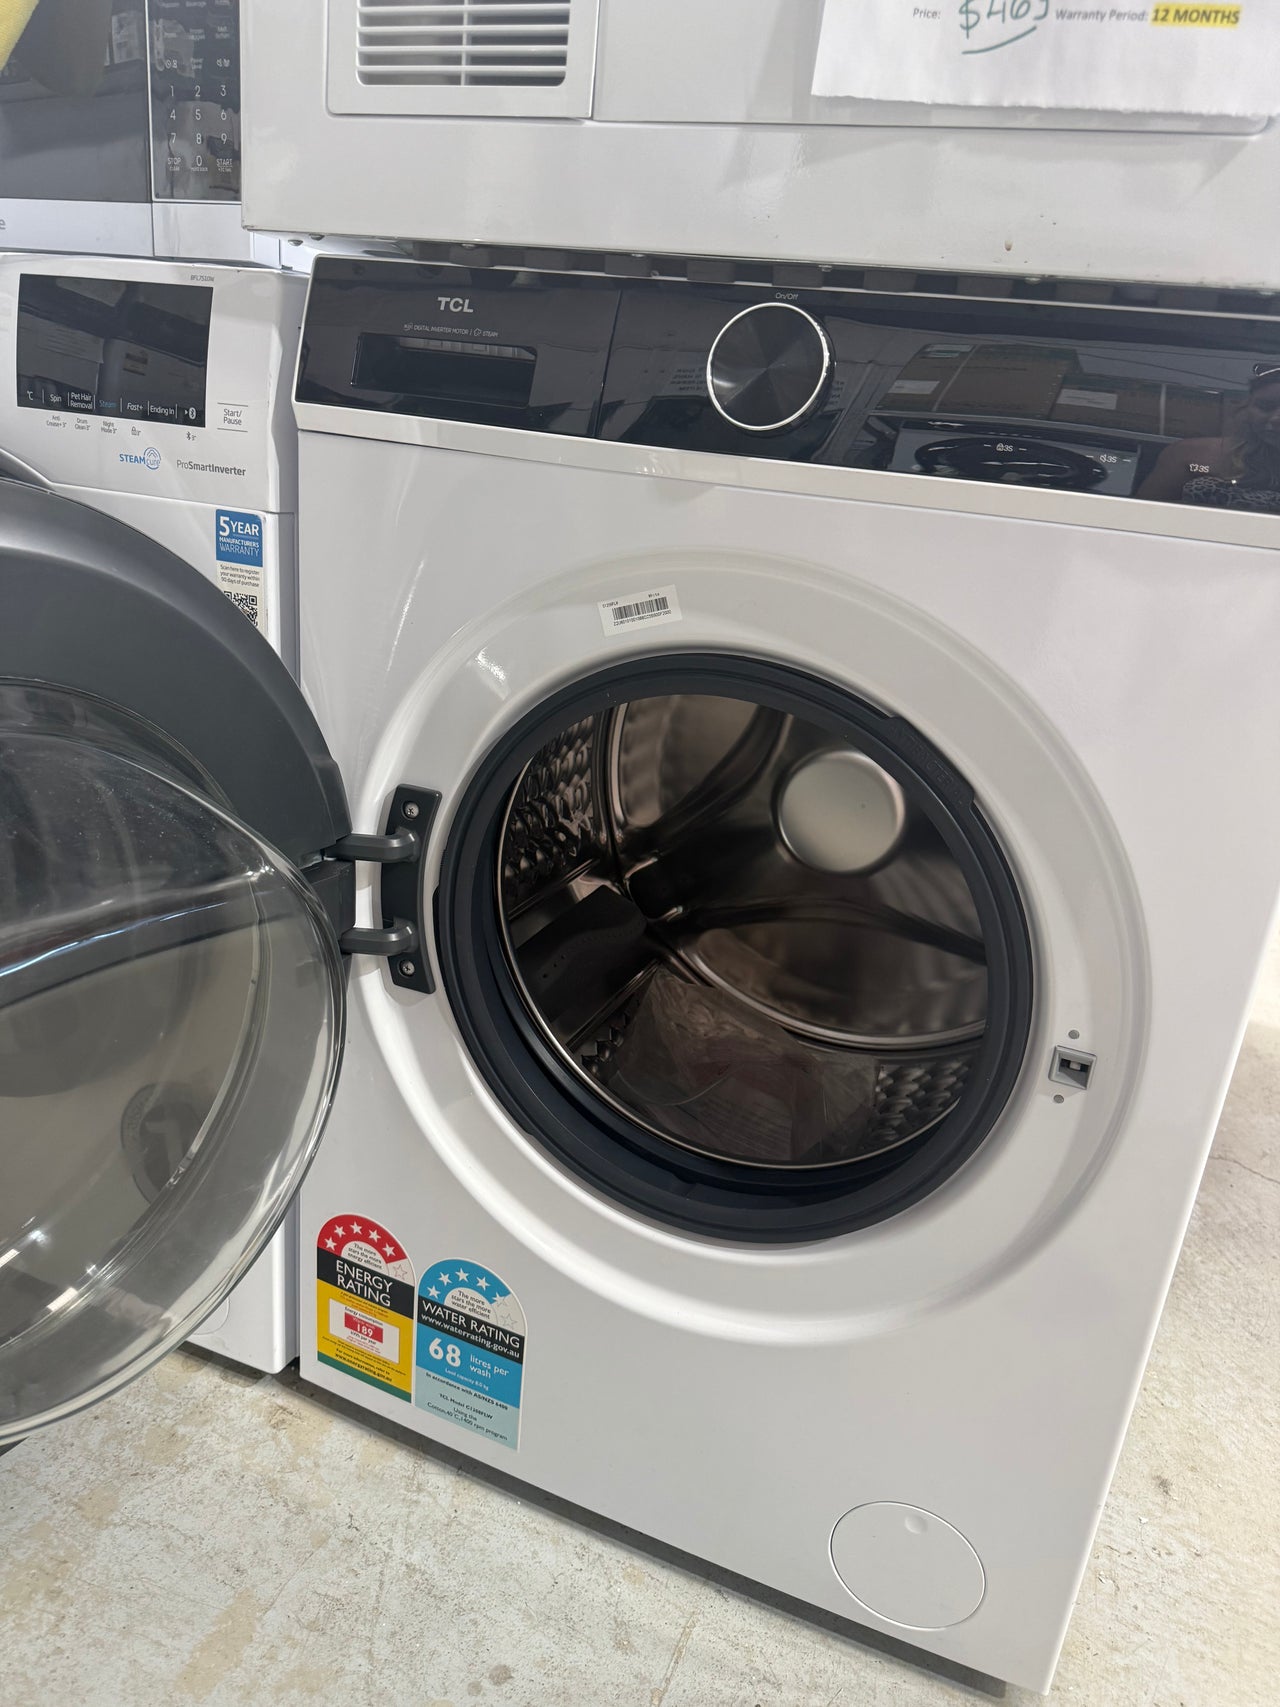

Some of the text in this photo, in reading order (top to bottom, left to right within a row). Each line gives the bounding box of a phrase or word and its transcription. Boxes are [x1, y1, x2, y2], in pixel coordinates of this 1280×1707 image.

[913, 8, 941, 19] Price:
[1055, 9, 1240, 24] Warranty Period: 12 MONTHS
[170, 85, 174, 96] 1
[194, 85, 201, 97] 2
[220, 85, 227, 97] 3
[170, 109, 176, 121] 4
[195, 109, 202, 120] 5
[220, 109, 227, 120] 6
[171, 133, 177, 144] 7
[196, 133, 202, 144] 8
[220, 133, 227, 144] 9
[167, 157, 182, 165] STOP
[196, 155, 203, 167] 0
[216, 158, 233, 166] START
[775, 292, 799, 300] On/Off
[438, 296, 474, 313] TCL
[452, 328, 469, 336] MOTOR
[50, 393, 62, 403] Spin
[70, 392, 92, 402] Pet Hair
[70, 400, 93, 410] Removal
[99, 399, 117, 408] Steam
[126, 402, 144, 412] Fast+
[150, 404, 175, 416] Ending In
[223, 408, 242, 418] Start/
[223, 416, 242, 426] Pause
[176, 460, 246, 476] ProSmartInverter
[219, 515, 259, 537] 5 YEAR
[219, 536, 260, 548] MANUFACTURERS
[219, 543, 260, 557] WARRANTY
[348, 1247, 382, 1264] stars the more
[354, 1242, 377, 1257] The more
[347, 1252, 382, 1269] energy efficient
[336, 1259, 393, 1293] ENERGY
[337, 1274, 391, 1307] RATING
[451, 1294, 492, 1314] stars the more
[458, 1290, 485, 1306] The more
[344, 1306, 358, 1316] Energy
[451, 1301, 491, 1320] water efficient
[357, 1323, 373, 1337] 189
[422, 1300, 467, 1328] WATER
[470, 1320, 520, 1349] RATING
[421, 1313, 520, 1358] www.waterrating.gov.au
[429, 1337, 462, 1368] 68
[470, 1354, 510, 1377] litres per
[469, 1365, 491, 1379] wash
[432, 1375, 461, 1390] accordance
[461, 1388, 473, 1396] with
[473, 1393, 495, 1405] AS/NZS
[439, 1393, 450, 1401] TCL
[449, 1398, 465, 1408] Model
[453, 1407, 468, 1418] Using
[473, 1423, 485, 1431] rpm
[485, 1428, 508, 1441] program
